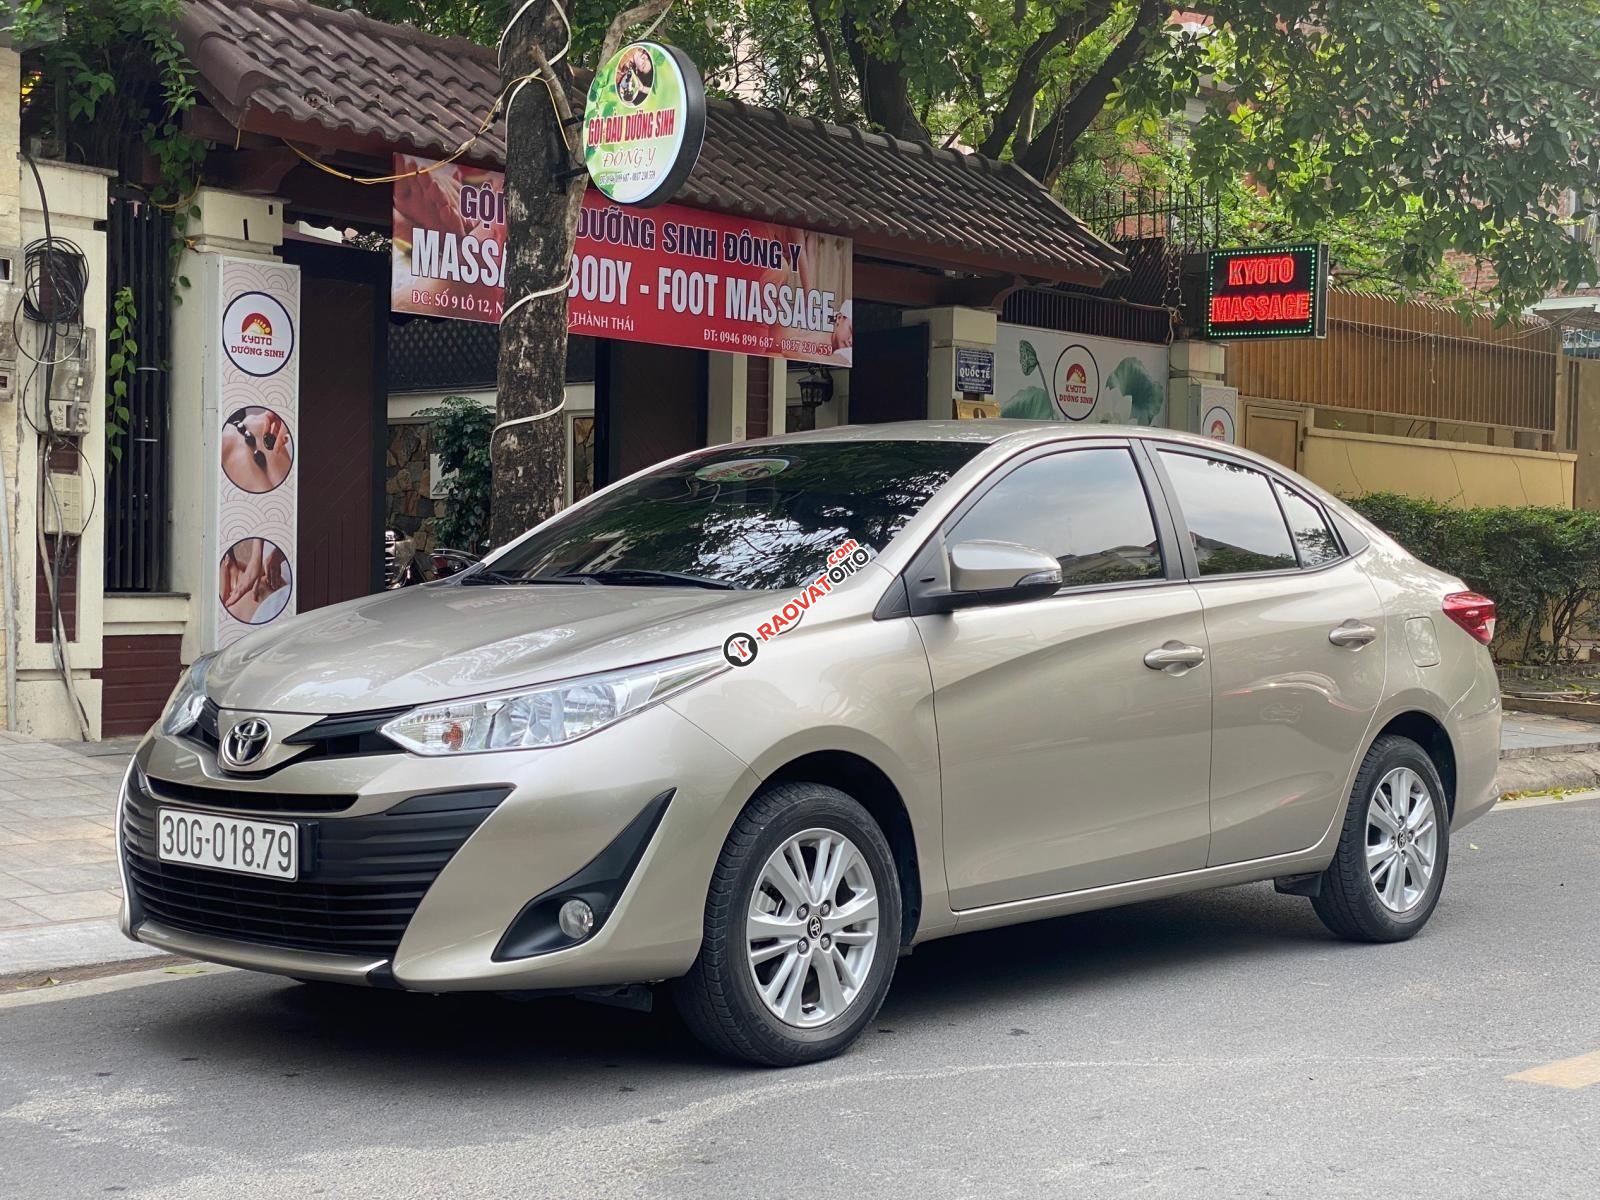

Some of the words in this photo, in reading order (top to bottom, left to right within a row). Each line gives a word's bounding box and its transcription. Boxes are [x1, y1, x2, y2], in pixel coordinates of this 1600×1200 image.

[655, 109, 675, 137] SINH
[460, 182, 505, 229] GỘI
[576, 204, 656, 251] DƯỠNG
[662, 221, 718, 260] SINH
[722, 228, 783, 270] ĐÔNG
[788, 242, 802, 273] Y
[1228, 257, 1295, 286] KYOTO
[411, 289, 432, 305] ĐC:
[435, 288, 449, 307] SỐ
[451, 296, 459, 309] 9
[461, 294, 475, 311] LÔ
[478, 299, 492, 316] 12,
[657, 266, 719, 317] FOOT
[725, 276, 836, 333] MASSAGE
[1211, 292, 1310, 323] MASSAGE
[572, 310, 609, 329] THÀNH
[611, 315, 634, 332] THÁI
[241, 334, 272, 346] KYOTO
[264, 349, 285, 359] SINH
[703, 328, 718, 342] ĐT:
[719, 331, 740, 345] 0946
[742, 334, 757, 347] 899
[759, 336, 774, 348] 687
[801, 341, 817, 354] 230
[818, 343, 833, 356] 559
[959, 365, 980, 378] QUỐC
[1066, 384, 1087, 394] KYOTO
[162, 815, 292, 873] 30G-018.79
